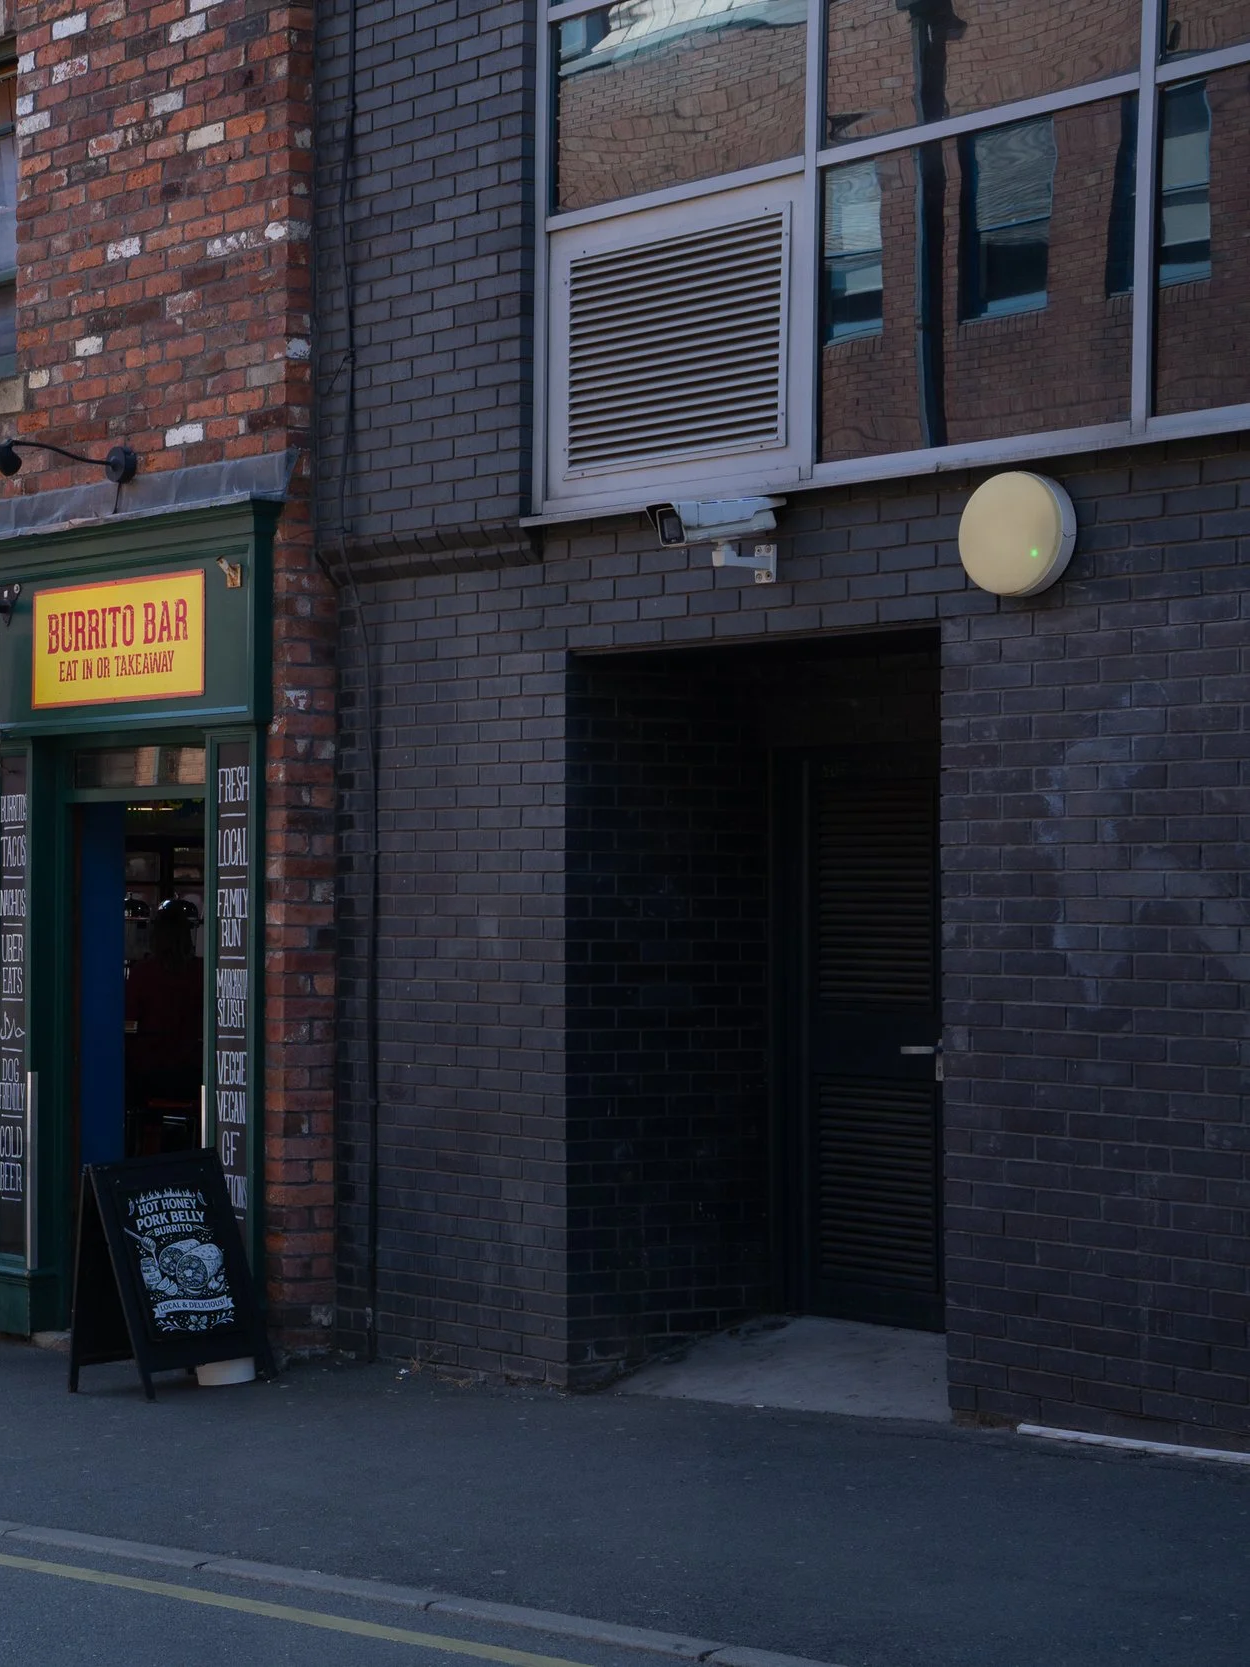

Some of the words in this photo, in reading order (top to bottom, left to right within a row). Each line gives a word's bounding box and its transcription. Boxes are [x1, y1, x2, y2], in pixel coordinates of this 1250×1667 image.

[47, 604, 136, 655] BURRITO
[142, 598, 189, 645] BAR
[58, 660, 79, 683] EAT
[82, 658, 93, 680] IN
[96, 656, 111, 679] OR
[114, 650, 175, 677] TAKEAWAY
[217, 766, 249, 804] FRESH
[0, 793, 27, 823] BURRITOS
[0, 835, 27, 867] TACOS
[217, 827, 249, 867] LOCAL
[0, 889, 26, 917] NACHOS
[217, 888, 249, 919] FAMILY
[1, 934, 24, 963] UBER
[221, 919, 242, 948] RUN
[2, 966, 23, 994] EATS
[217, 998, 246, 1029] SLUSH
[2, 1057, 20, 1083] DOG
[216, 1050, 247, 1086] VEGGIE
[216, 1090, 247, 1124] VEGAN
[0, 1125, 23, 1159] COLD
[221, 1130, 241, 1167] GF
[0, 1161, 23, 1193] BEER
[136, 1212, 170, 1231] PORK
[170, 1210, 205, 1223] BELLY
[138, 1200, 159, 1216] HOT
[161, 1198, 197, 1210] HONEY
[154, 1223, 193, 1237] BURRITO
[160, 1302, 180, 1312] LOCAL
[189, 1298, 226, 1309] DELICIOUS!
